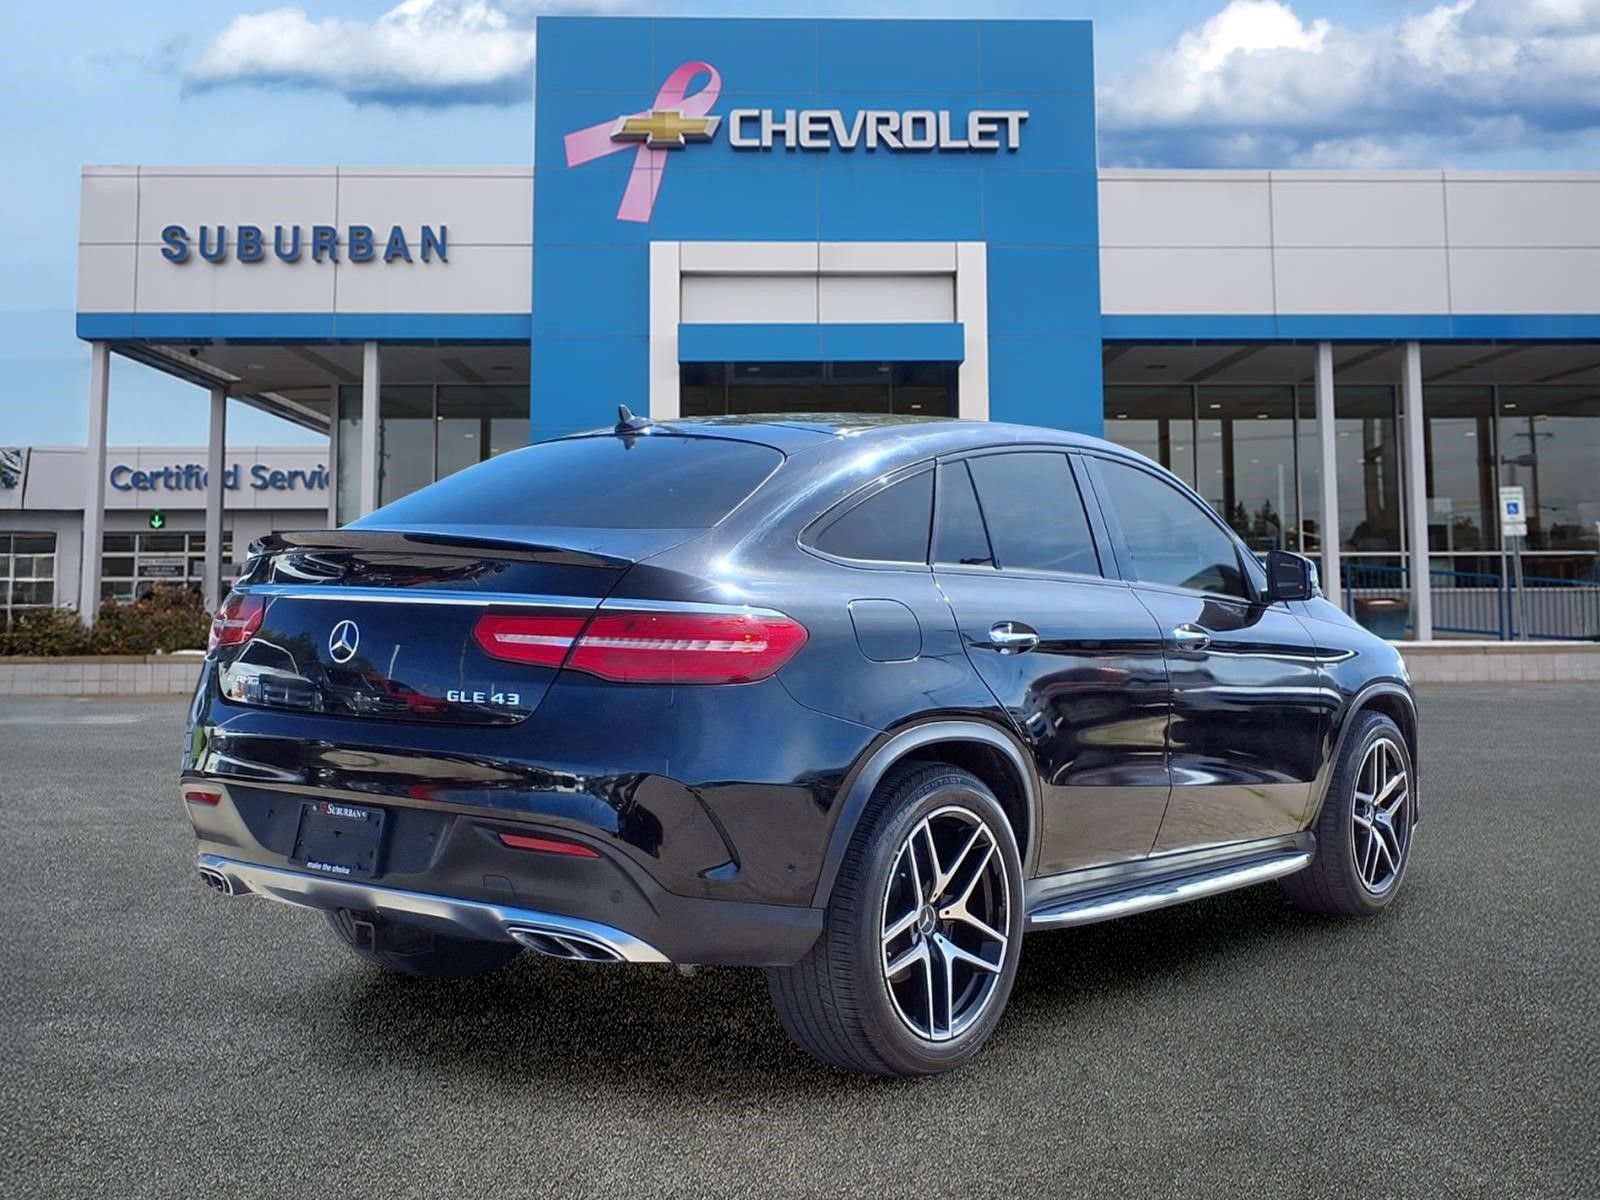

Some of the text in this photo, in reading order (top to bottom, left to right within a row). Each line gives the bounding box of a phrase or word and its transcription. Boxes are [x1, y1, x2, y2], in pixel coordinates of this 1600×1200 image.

[728, 108, 1030, 150] CHEVROLET
[160, 224, 450, 264] SUBURBAN
[109, 463, 330, 492] Certifid Servi
[446, 690, 520, 706] GLE 43
